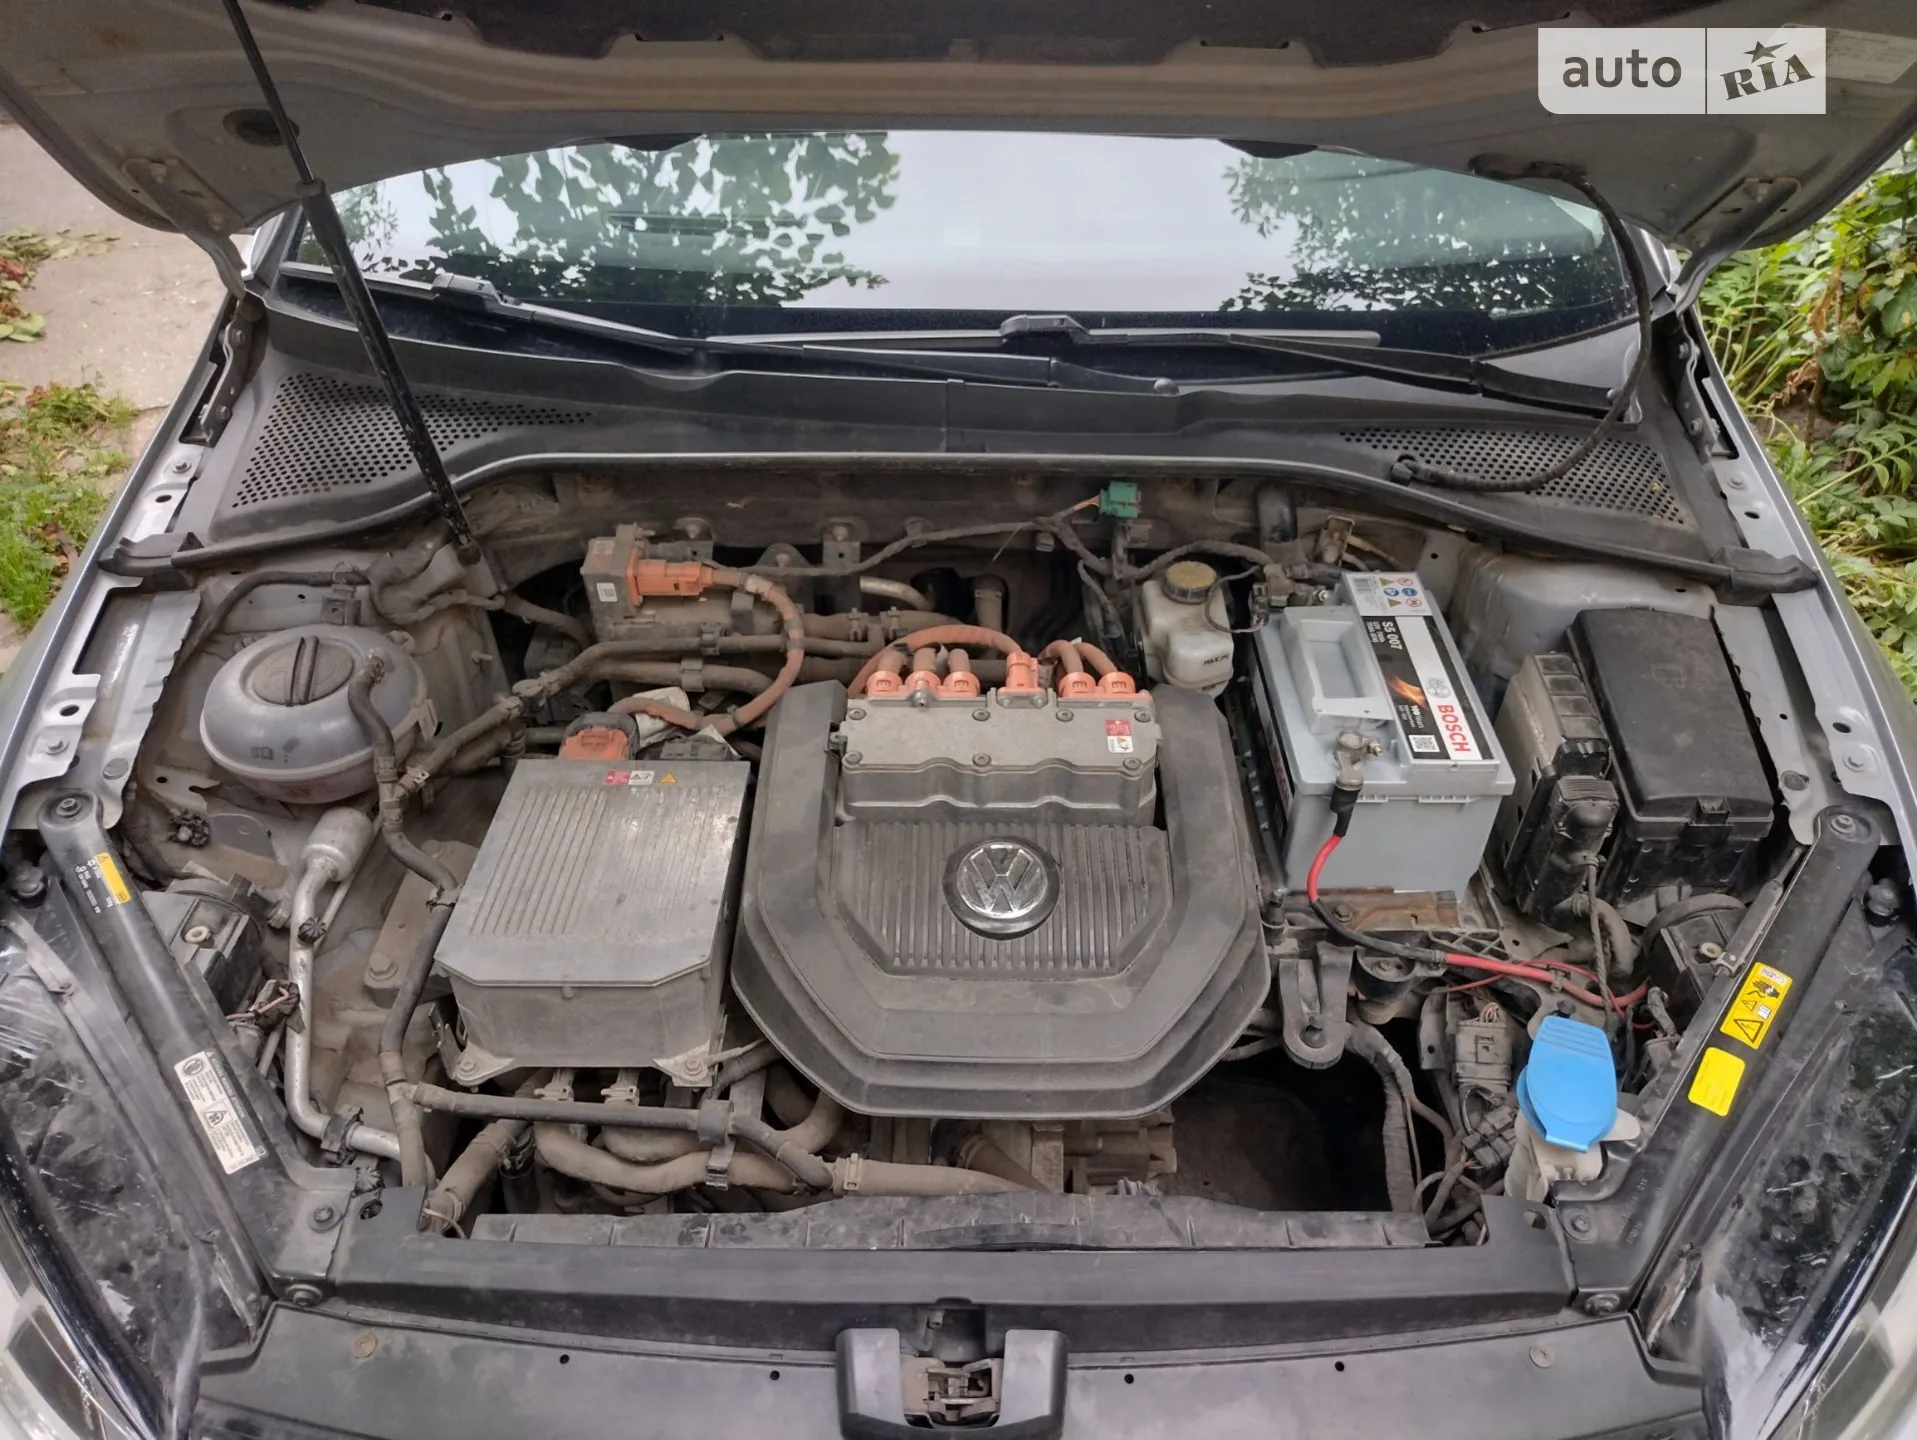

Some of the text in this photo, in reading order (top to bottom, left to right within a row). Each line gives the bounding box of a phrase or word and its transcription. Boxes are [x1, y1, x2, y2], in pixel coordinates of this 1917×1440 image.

[1381, 620, 1396, 633] S5
[1386, 633, 1403, 650] 007
[1437, 704, 1472, 752] BOSCH
[960, 845, 1046, 918] VW
